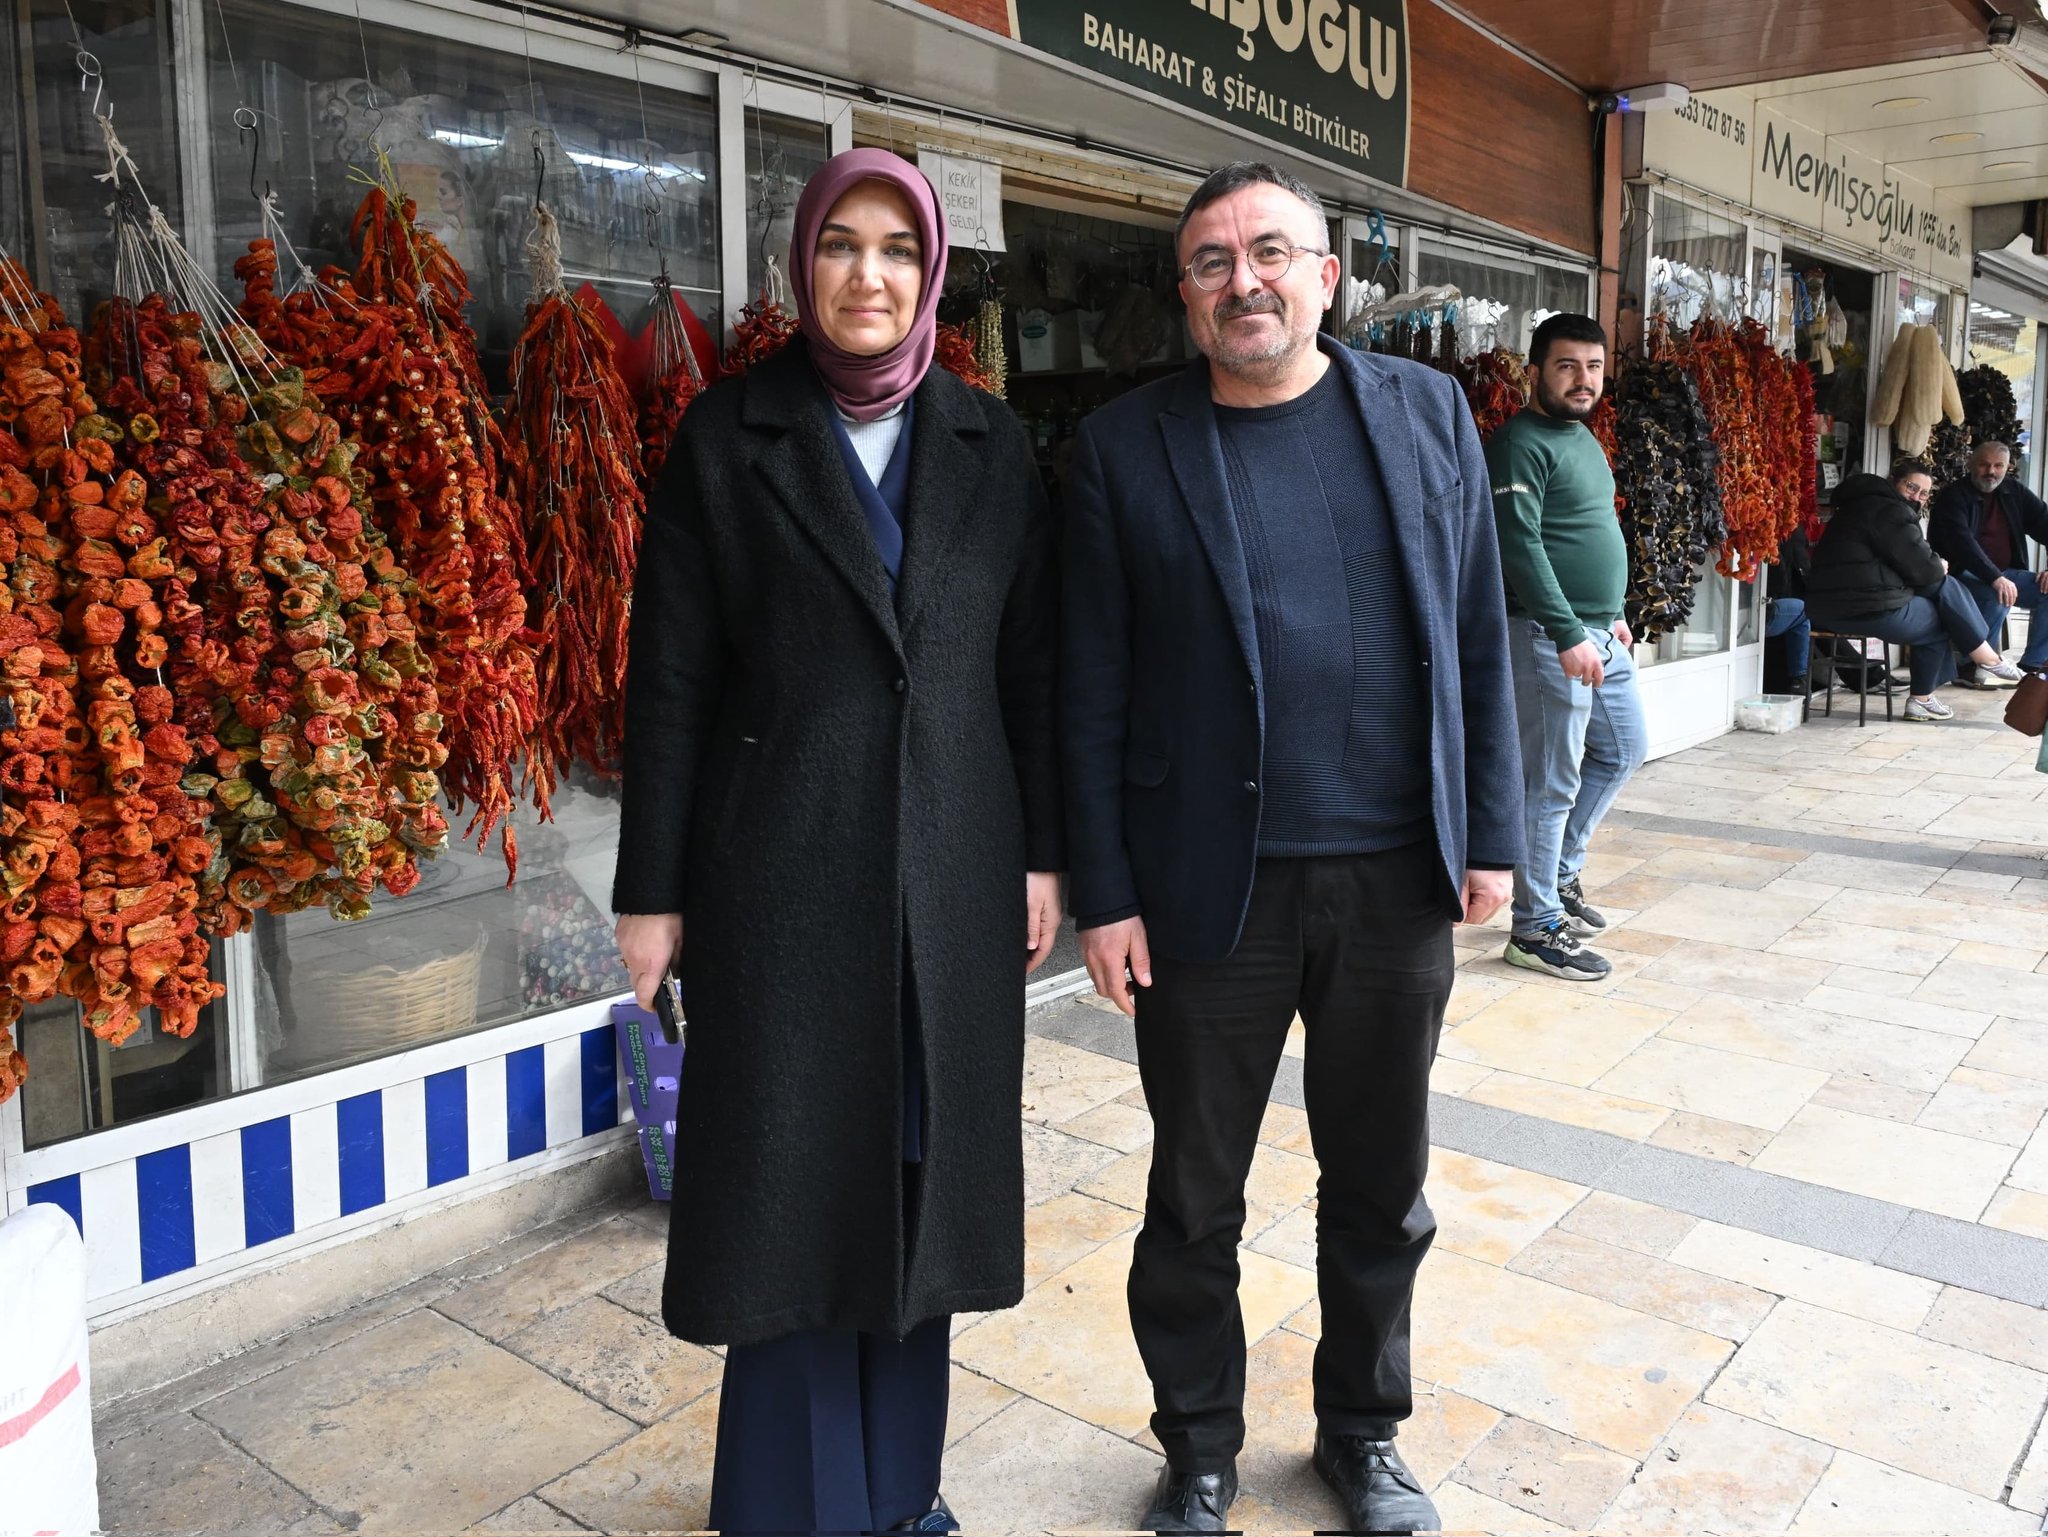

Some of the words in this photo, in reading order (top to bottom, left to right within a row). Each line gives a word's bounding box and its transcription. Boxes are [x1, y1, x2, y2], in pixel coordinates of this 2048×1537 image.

[1084, 12, 1195, 88] BAHARAT
[1202, 66, 1217, 99] &
[1223, 73, 1287, 126] ŞİFALI
[1293, 102, 1370, 159] BİTKİLER
[1674, 96, 1699, 124] 53
[1702, 102, 1719, 132] 727
[1721, 112, 1732, 139] 87
[1735, 118, 1745, 146] 56
[948, 171, 977, 190] KEKİK
[945, 192, 978, 211] ŞEKERİ
[627, 1024, 640, 1063] Product
[635, 1064, 643, 1076] of
[638, 1077, 649, 1105] China
